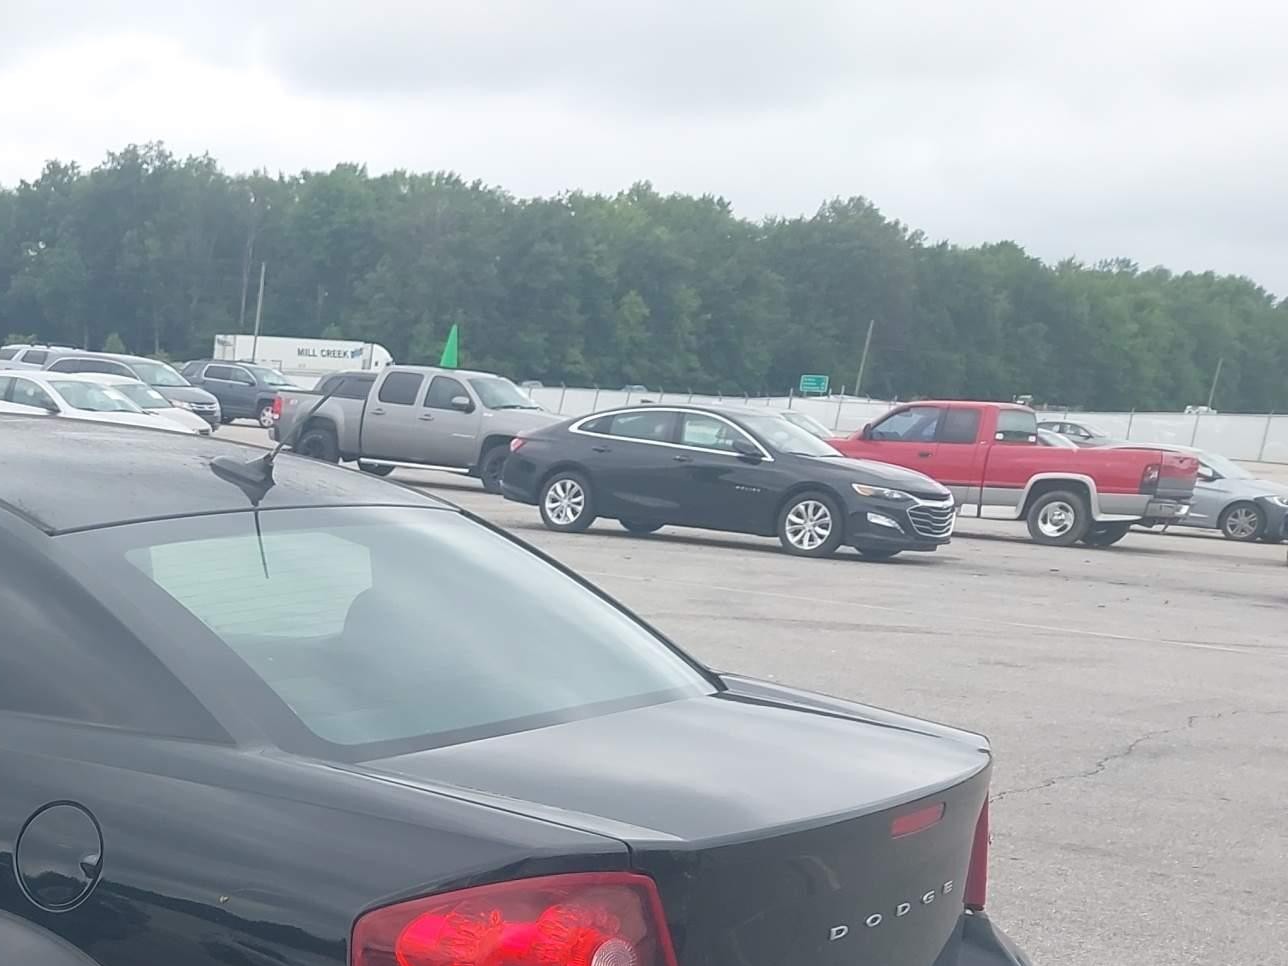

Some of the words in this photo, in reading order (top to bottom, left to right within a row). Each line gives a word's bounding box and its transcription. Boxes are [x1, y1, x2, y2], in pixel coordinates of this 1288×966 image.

[297, 347, 318, 357] MILL
[320, 348, 350, 359] CREEK
[829, 879, 954, 941] DODGE
